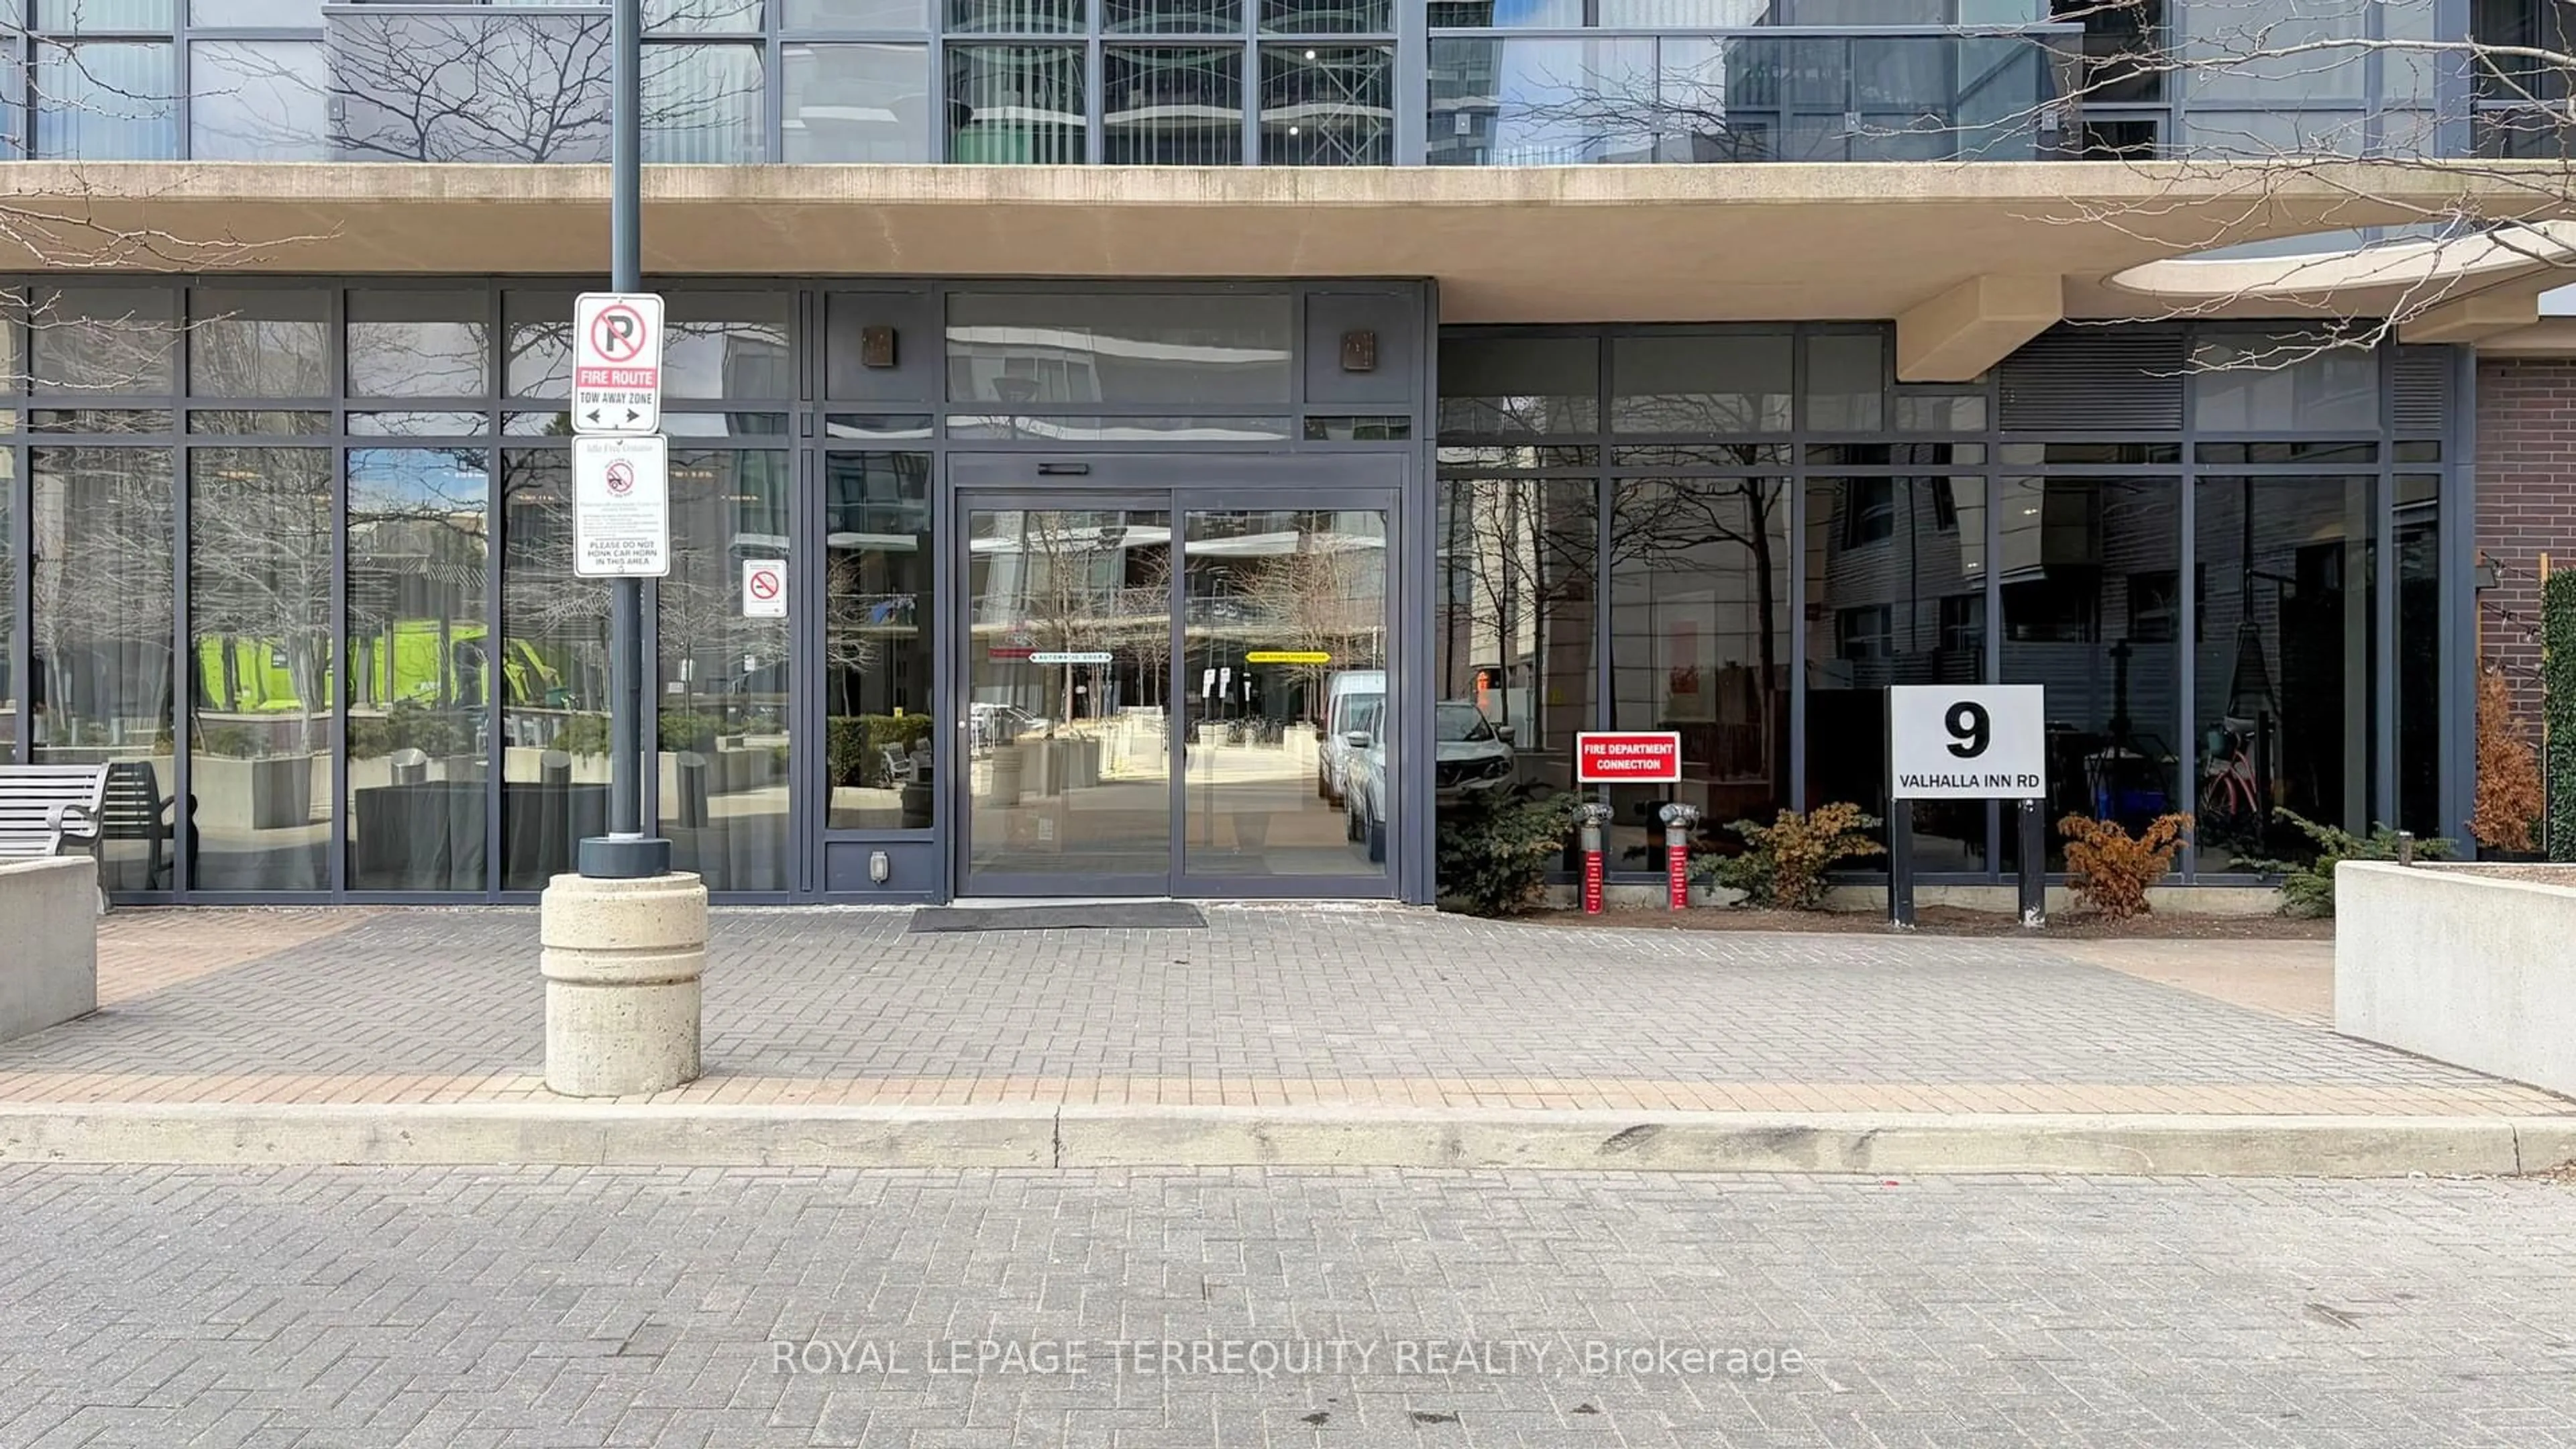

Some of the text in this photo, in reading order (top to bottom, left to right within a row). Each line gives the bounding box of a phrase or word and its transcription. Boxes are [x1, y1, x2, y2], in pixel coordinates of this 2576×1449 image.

[606, 315, 633, 352] P
[580, 370, 653, 386] FIRE ROUTE
[580, 392, 653, 405] TOW AWAY ZONE
[590, 541, 655, 549] PLEASE DO NOT
[587, 549, 657, 557] HONK CAR HORN
[1945, 701, 1990, 759] 9
[1584, 743, 1674, 754] FIRE DEPARTMENT
[1597, 759, 1661, 770] CONNECTION
[1899, 774, 2040, 788] VALHALLA INN RD
